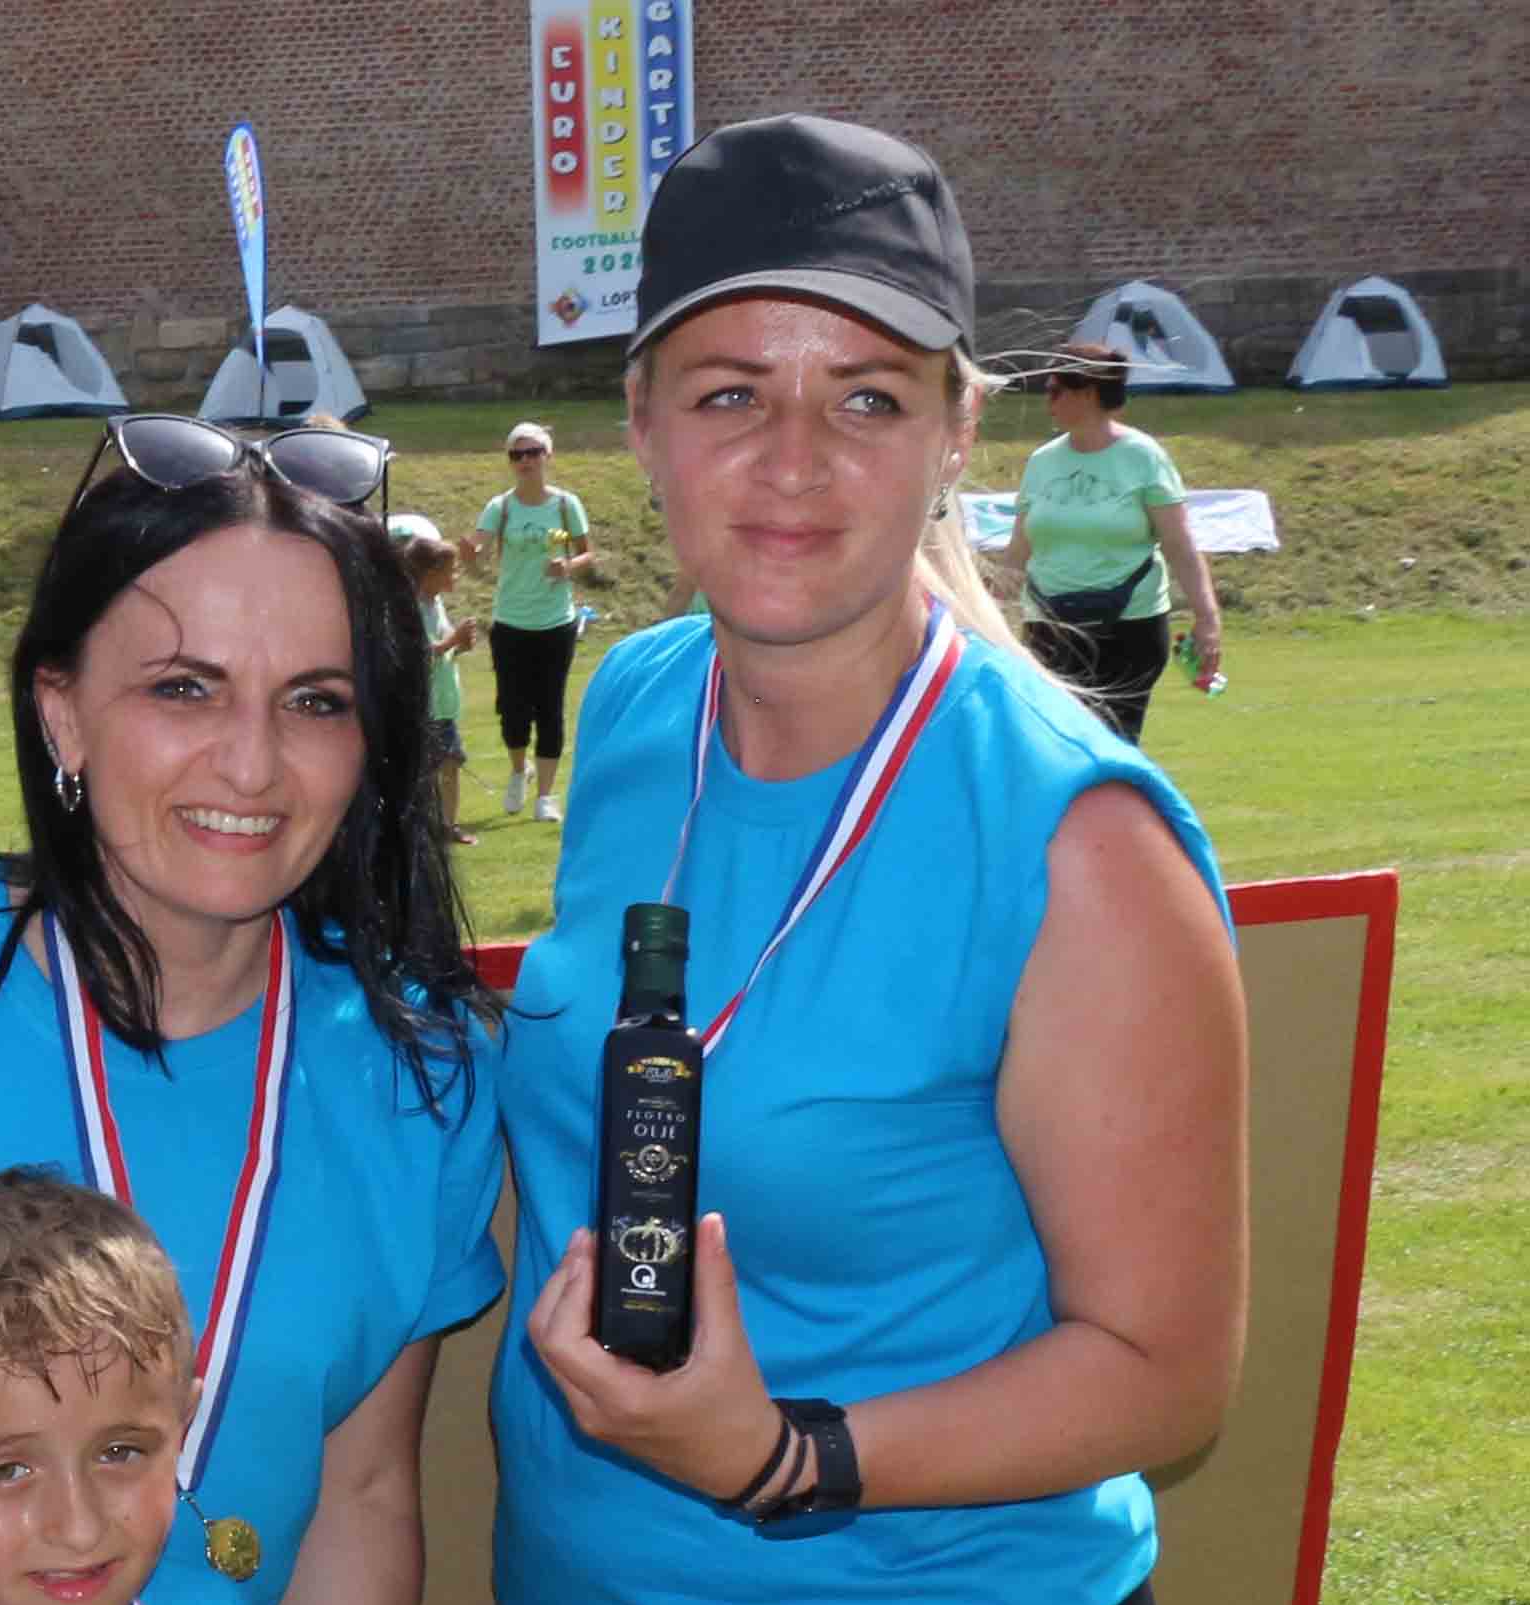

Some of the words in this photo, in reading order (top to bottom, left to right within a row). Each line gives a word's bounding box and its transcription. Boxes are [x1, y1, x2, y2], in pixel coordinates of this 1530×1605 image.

[550, 46, 578, 174] EURO
[598, 15, 629, 214] KINDER
[582, 251, 643, 275] 202
